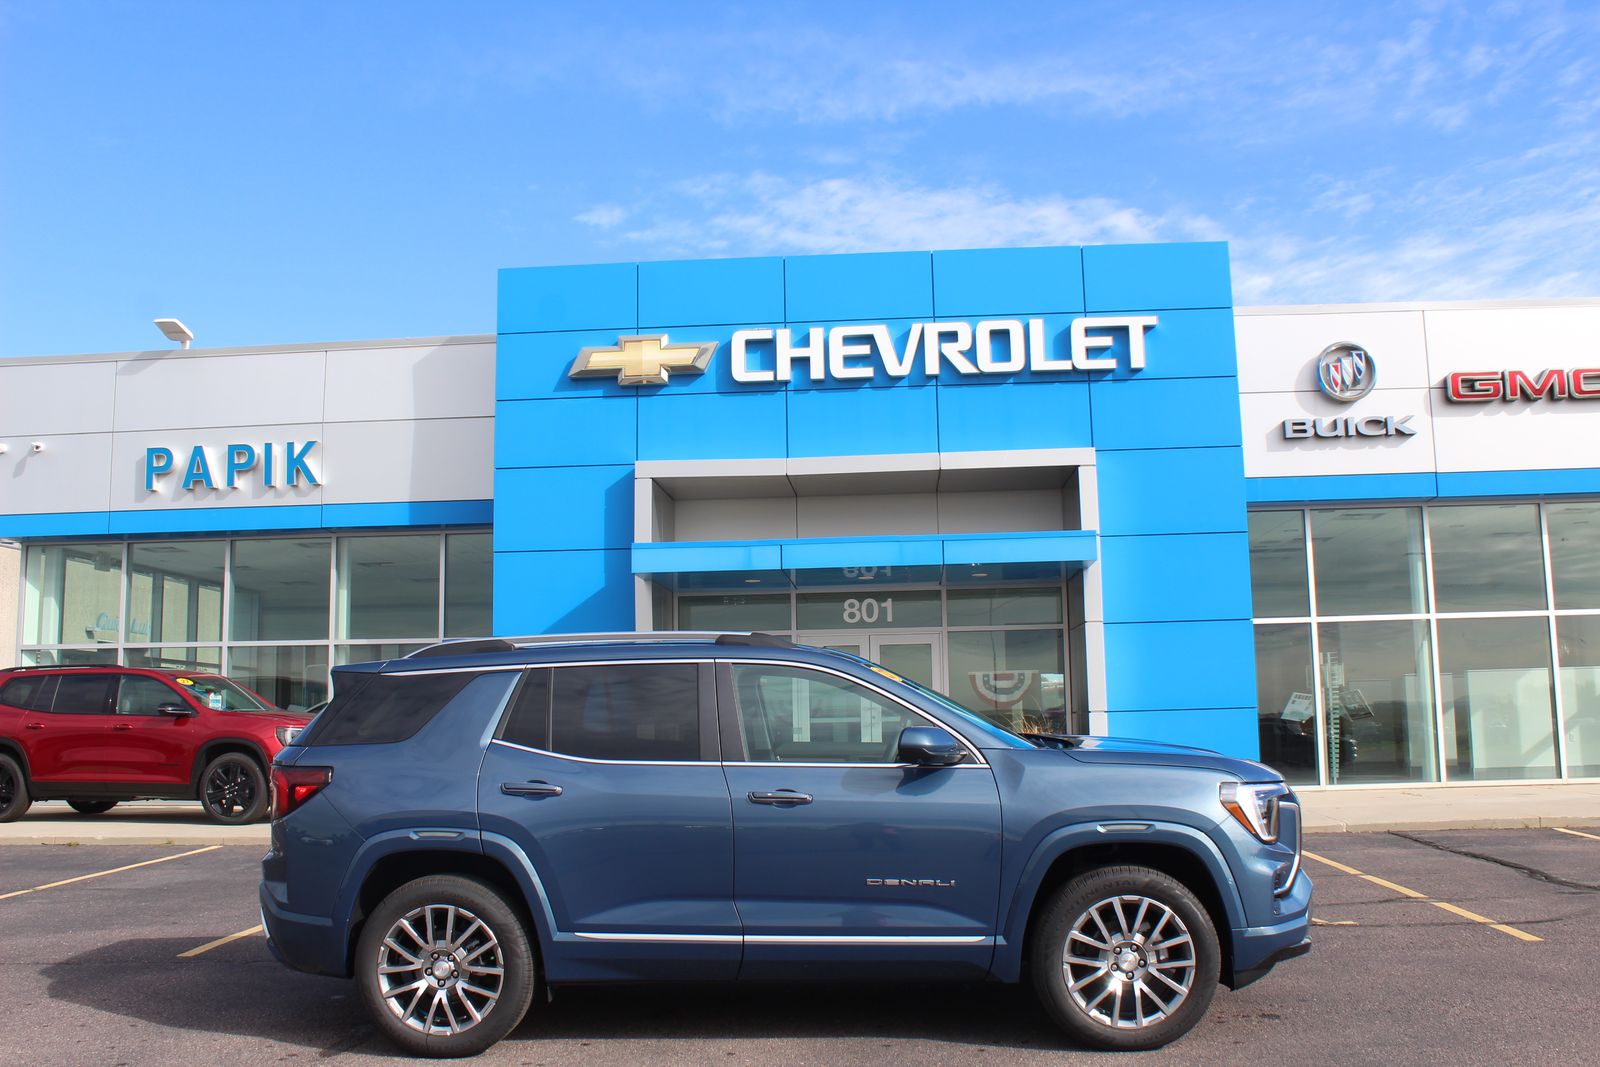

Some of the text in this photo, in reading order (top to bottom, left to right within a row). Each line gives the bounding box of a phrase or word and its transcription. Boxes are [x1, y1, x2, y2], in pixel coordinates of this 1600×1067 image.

[731, 315, 1158, 384] CHEVROLET
[1447, 367, 1600, 402] GMC
[1283, 415, 1417, 439] BUICK
[145, 440, 322, 491] PAPIK
[843, 598, 893, 623] 801
[866, 878, 955, 886] DENALI
